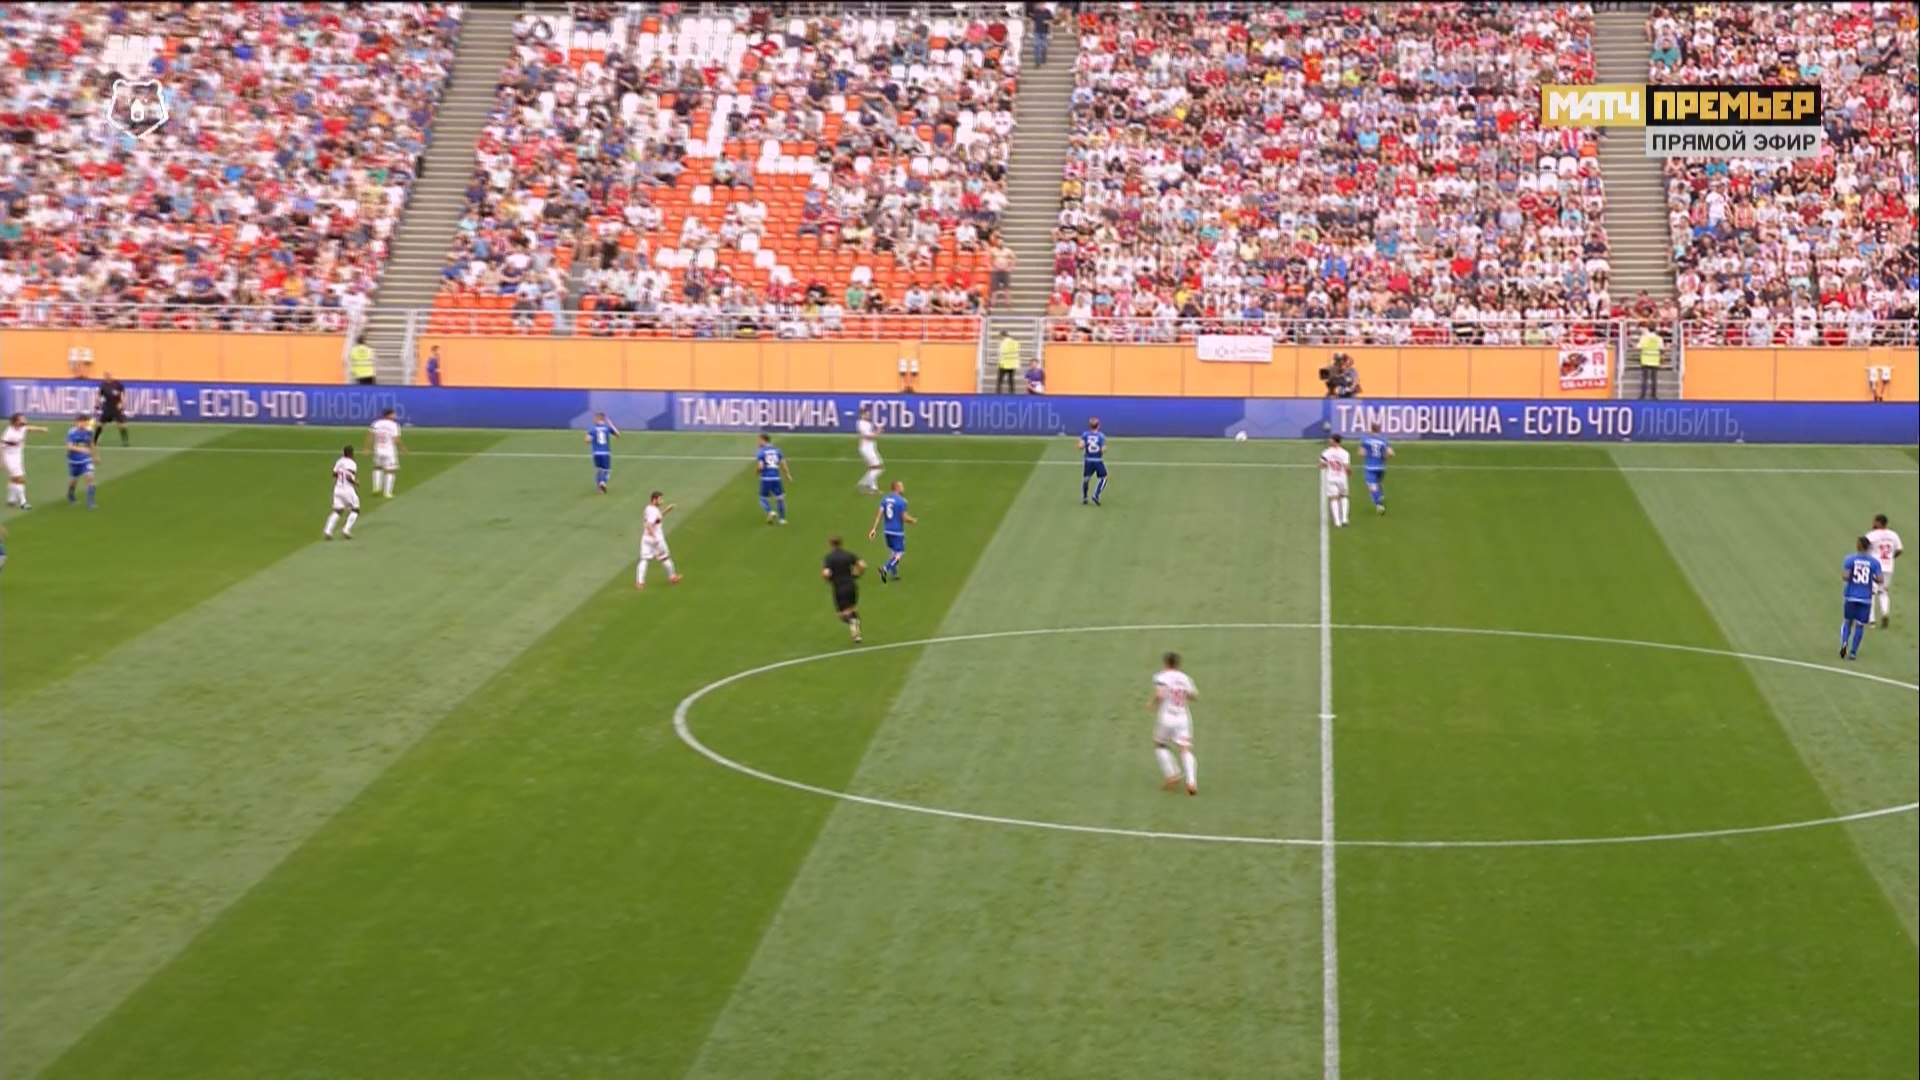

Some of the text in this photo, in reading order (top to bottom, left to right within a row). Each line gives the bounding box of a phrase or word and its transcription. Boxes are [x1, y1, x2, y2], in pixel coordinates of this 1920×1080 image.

[11, 385, 182, 417] ТАМБОИНА
[200, 389, 259, 418] ЕСТЬ
[261, 390, 308, 419] ЧТО
[680, 398, 840, 429] ТАМБОВЩИНА
[920, 400, 963, 428] ЧТО
[1336, 405, 1502, 436] ТАМБОВЩИНА
[1524, 406, 1582, 434] ЕСТЬ
[1588, 406, 1633, 435] ЧТО
[1853, 567, 1871, 585] 58
